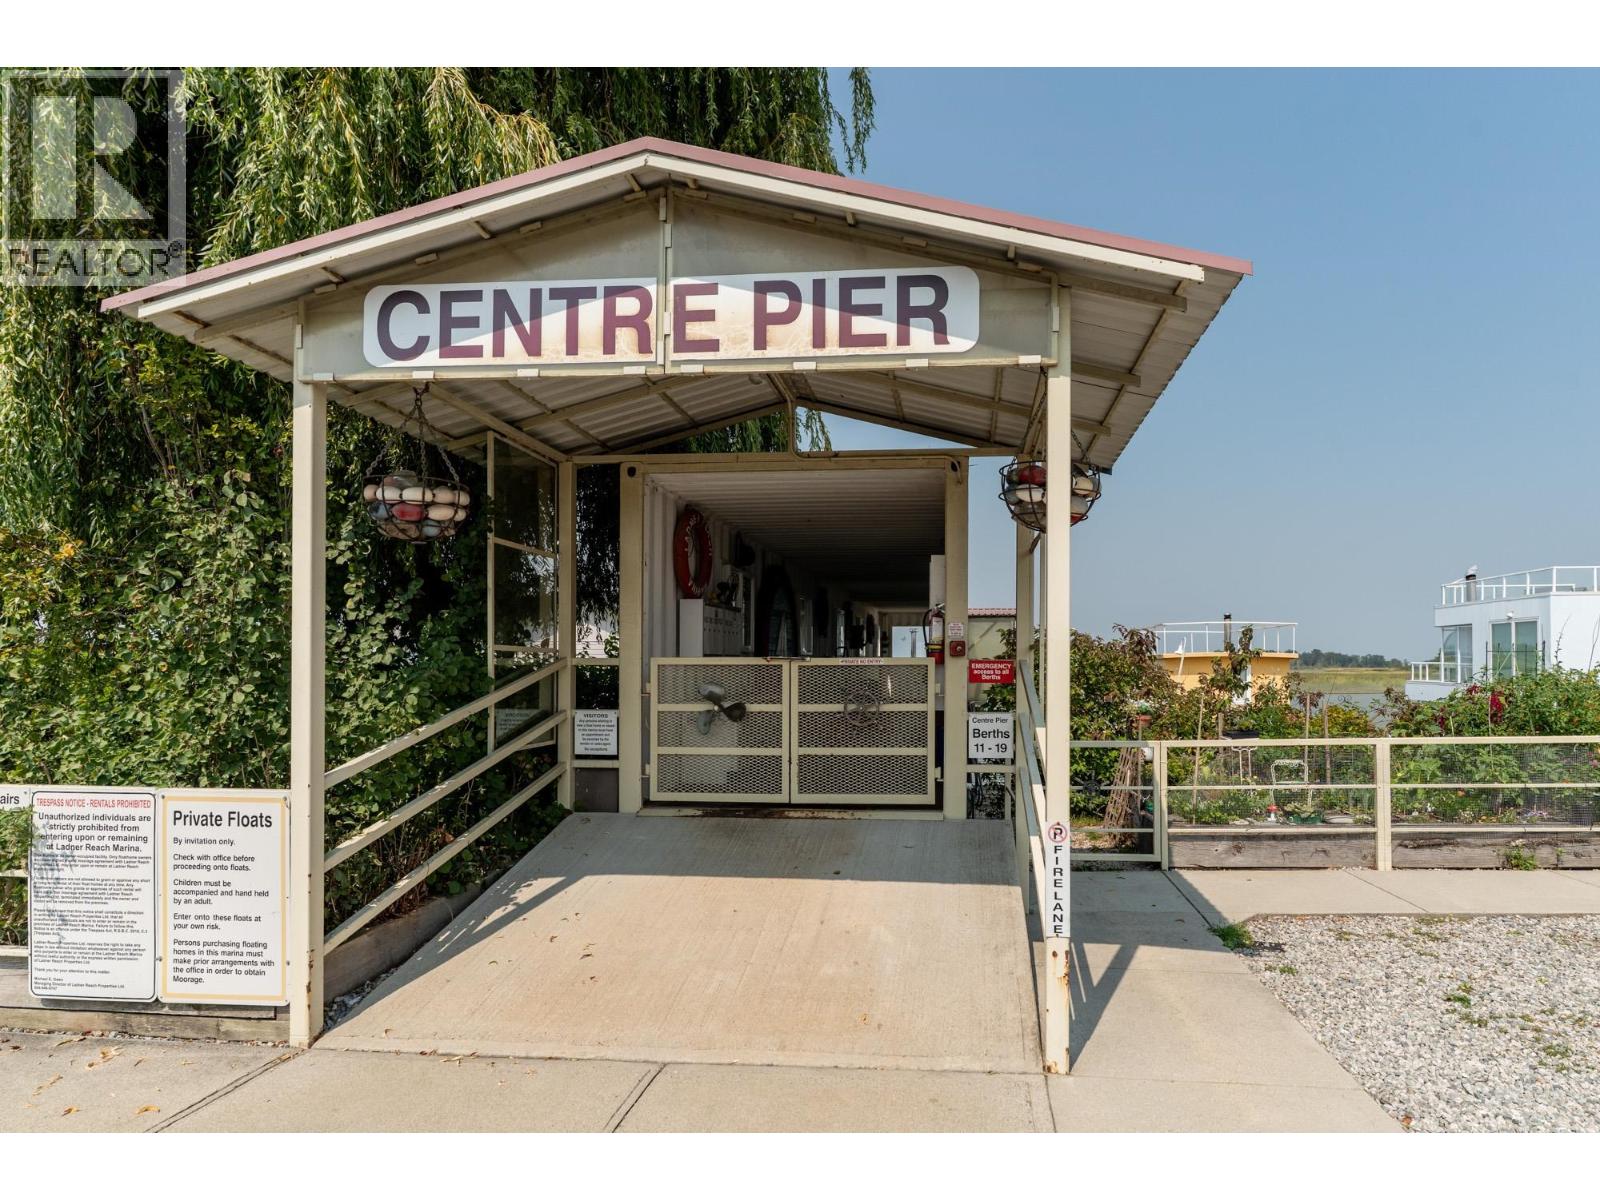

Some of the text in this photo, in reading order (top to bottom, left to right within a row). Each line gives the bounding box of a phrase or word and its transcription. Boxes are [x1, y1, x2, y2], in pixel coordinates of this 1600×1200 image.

[376, 275, 951, 362] CENTRE PIER
[972, 728, 1010, 739] Berths
[974, 743, 984, 752] 11
[995, 743, 1008, 752] 19
[36, 798, 64, 806] TRESPASS
[65, 799, 85, 807] NOTICE
[90, 799, 115, 808] RENTALS
[116, 800, 151, 808] PROHIBITED
[38, 812, 90, 821] Unauthorized
[92, 813, 136, 822] individuals
[173, 810, 272, 828] Private Floats
[48, 823, 139, 832] strictly prohibited from
[40, 833, 72, 842] entering
[74, 834, 94, 843] upon
[108, 834, 148, 844] remaining
[173, 837, 235, 847] By invitation only.
[112, 844, 142, 852] Marina.
[173, 853, 194, 861] Check
[213, 854, 231, 862] office
[173, 863, 211, 872] proceeding
[173, 878, 202, 886] Children
[173, 889, 219, 897] accompanied
[235, 889, 252, 897] hand
[173, 897, 182, 906] by
[173, 912, 191, 920] Enter
[233, 914, 252, 922] floats
[173, 938, 268, 950] Persons purchasing floating
[193, 958, 209, 966] prior
[211, 959, 258, 967] arrangements
[244, 968, 266, 976] obtain
[173, 975, 205, 985] Moorage.
